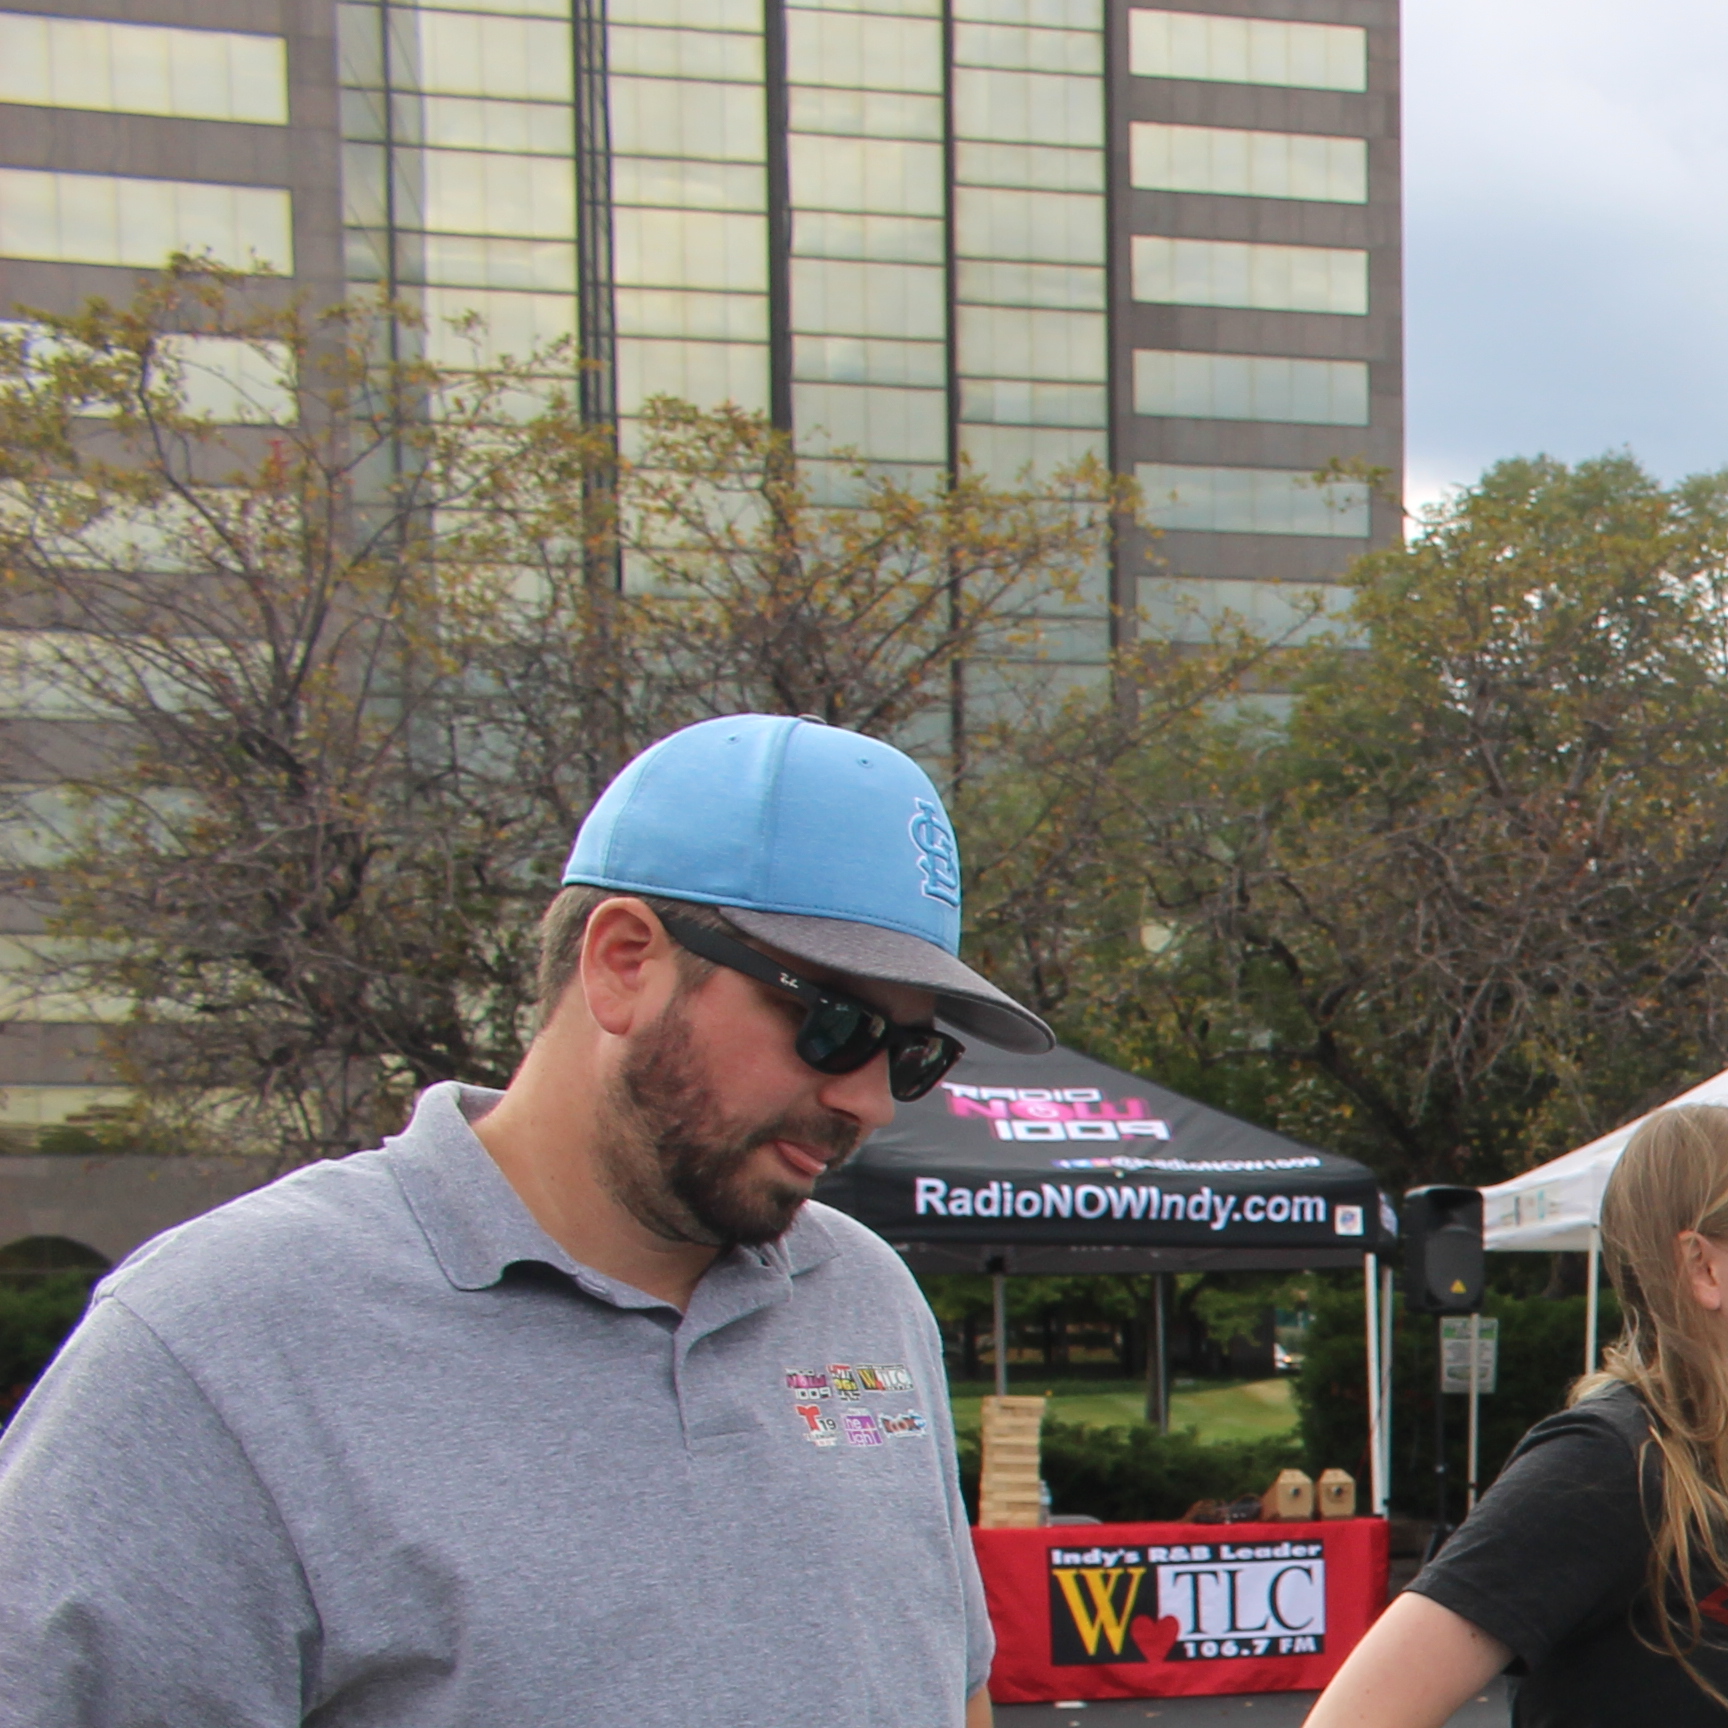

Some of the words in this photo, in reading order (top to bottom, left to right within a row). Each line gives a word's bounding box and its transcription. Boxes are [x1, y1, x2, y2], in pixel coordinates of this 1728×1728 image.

[941, 1081, 1100, 1102] RADIO
[947, 1096, 1148, 1122] NOW
[993, 1119, 1172, 1142] 1009
[914, 1176, 1328, 1230] RadioNOWIndy.com
[1051, 1549, 1141, 1567] Indy's
[1148, 1545, 1212, 1563] R&B
[1220, 1541, 1323, 1560] Leader
[1183, 1637, 1271, 1659] 106.7
[1279, 1636, 1317, 1654] FM
